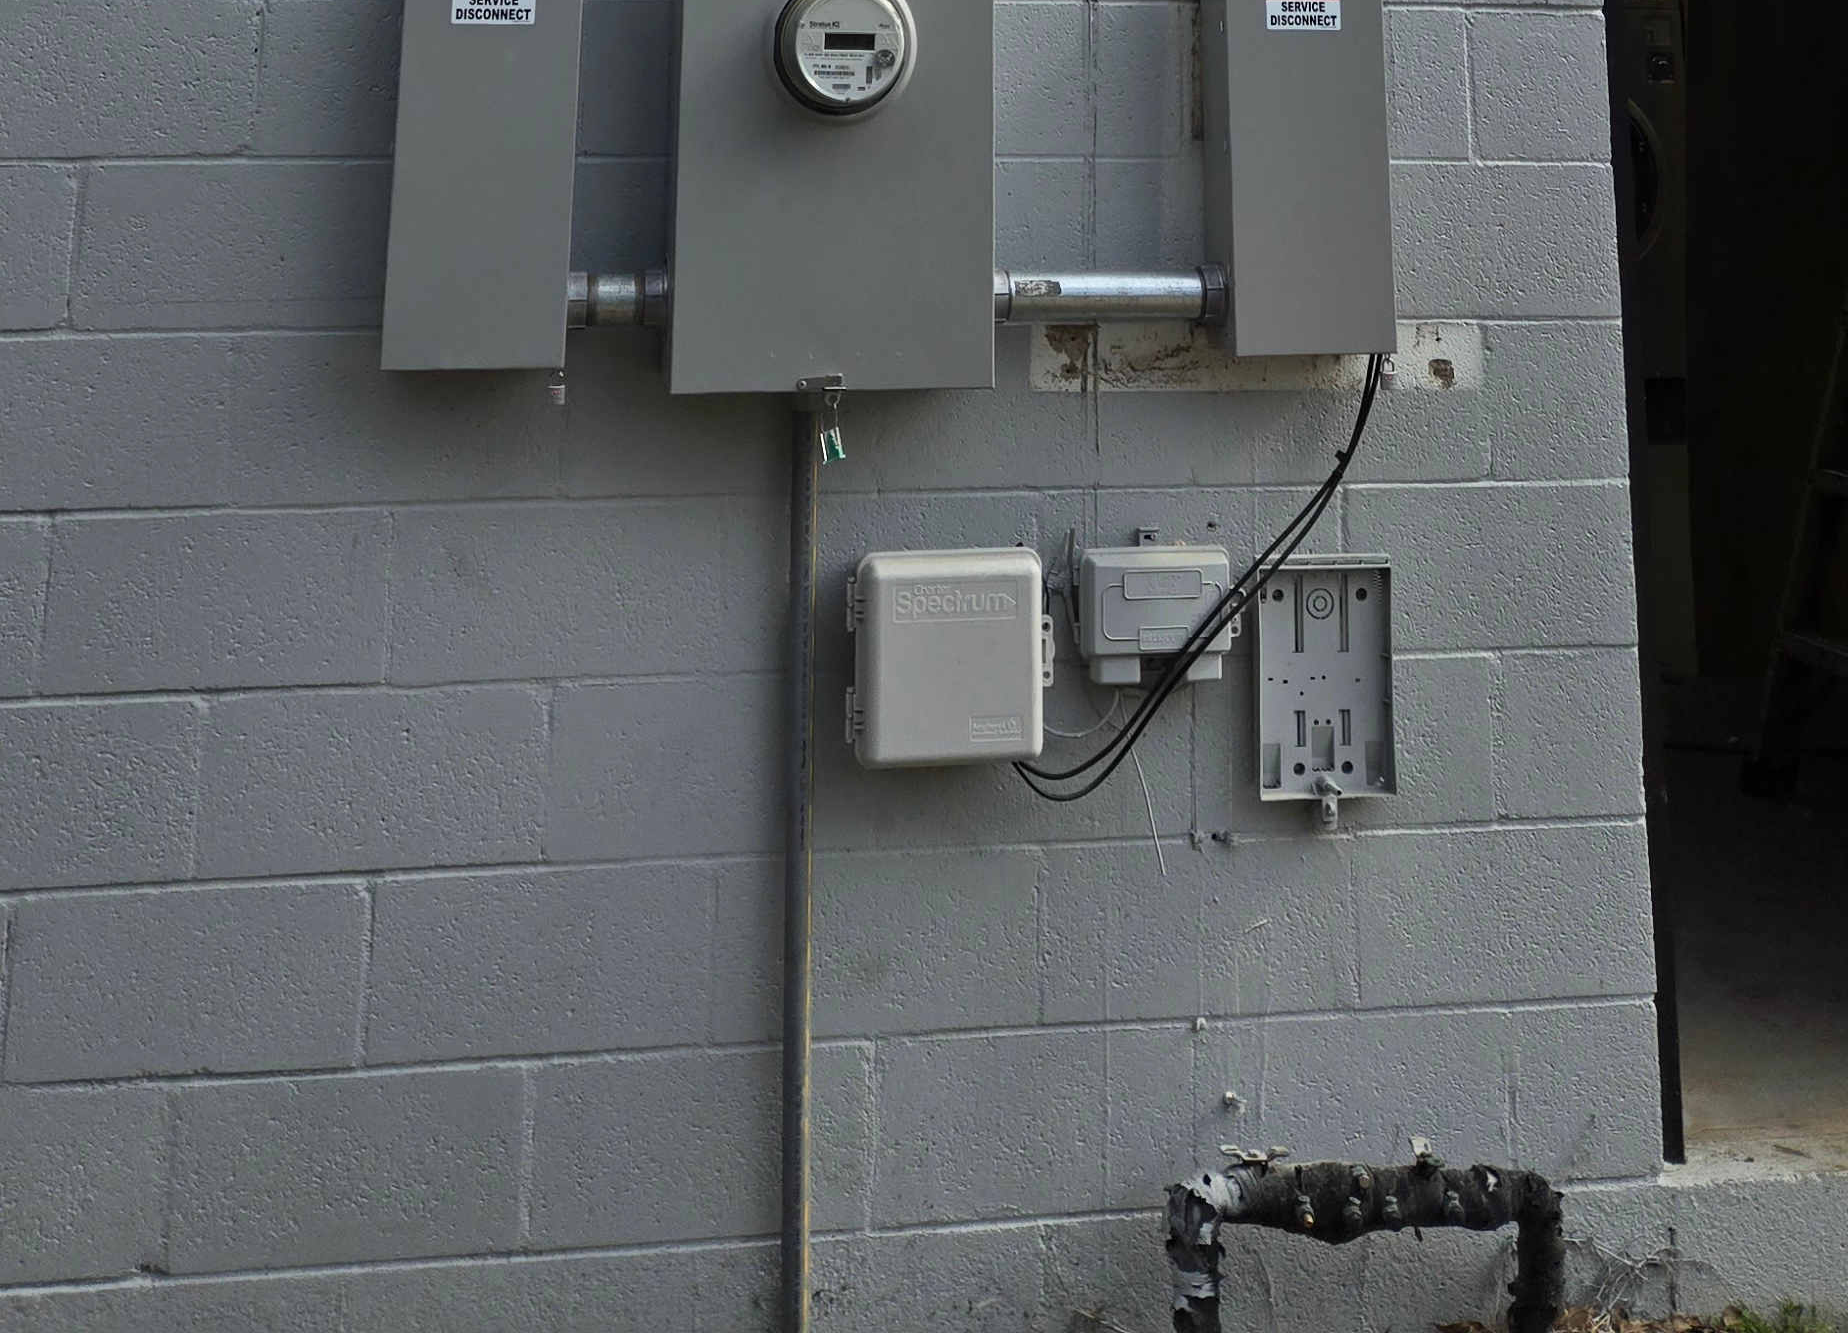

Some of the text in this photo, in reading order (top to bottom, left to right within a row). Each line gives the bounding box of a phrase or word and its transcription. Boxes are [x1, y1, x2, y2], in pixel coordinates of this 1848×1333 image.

[1281, 1, 1326, 13] SERVICE
[455, 8, 532, 21] DISCONNECT
[1270, 15, 1338, 27] DISCONNECT
[896, 590, 1010, 620] Spectrum
